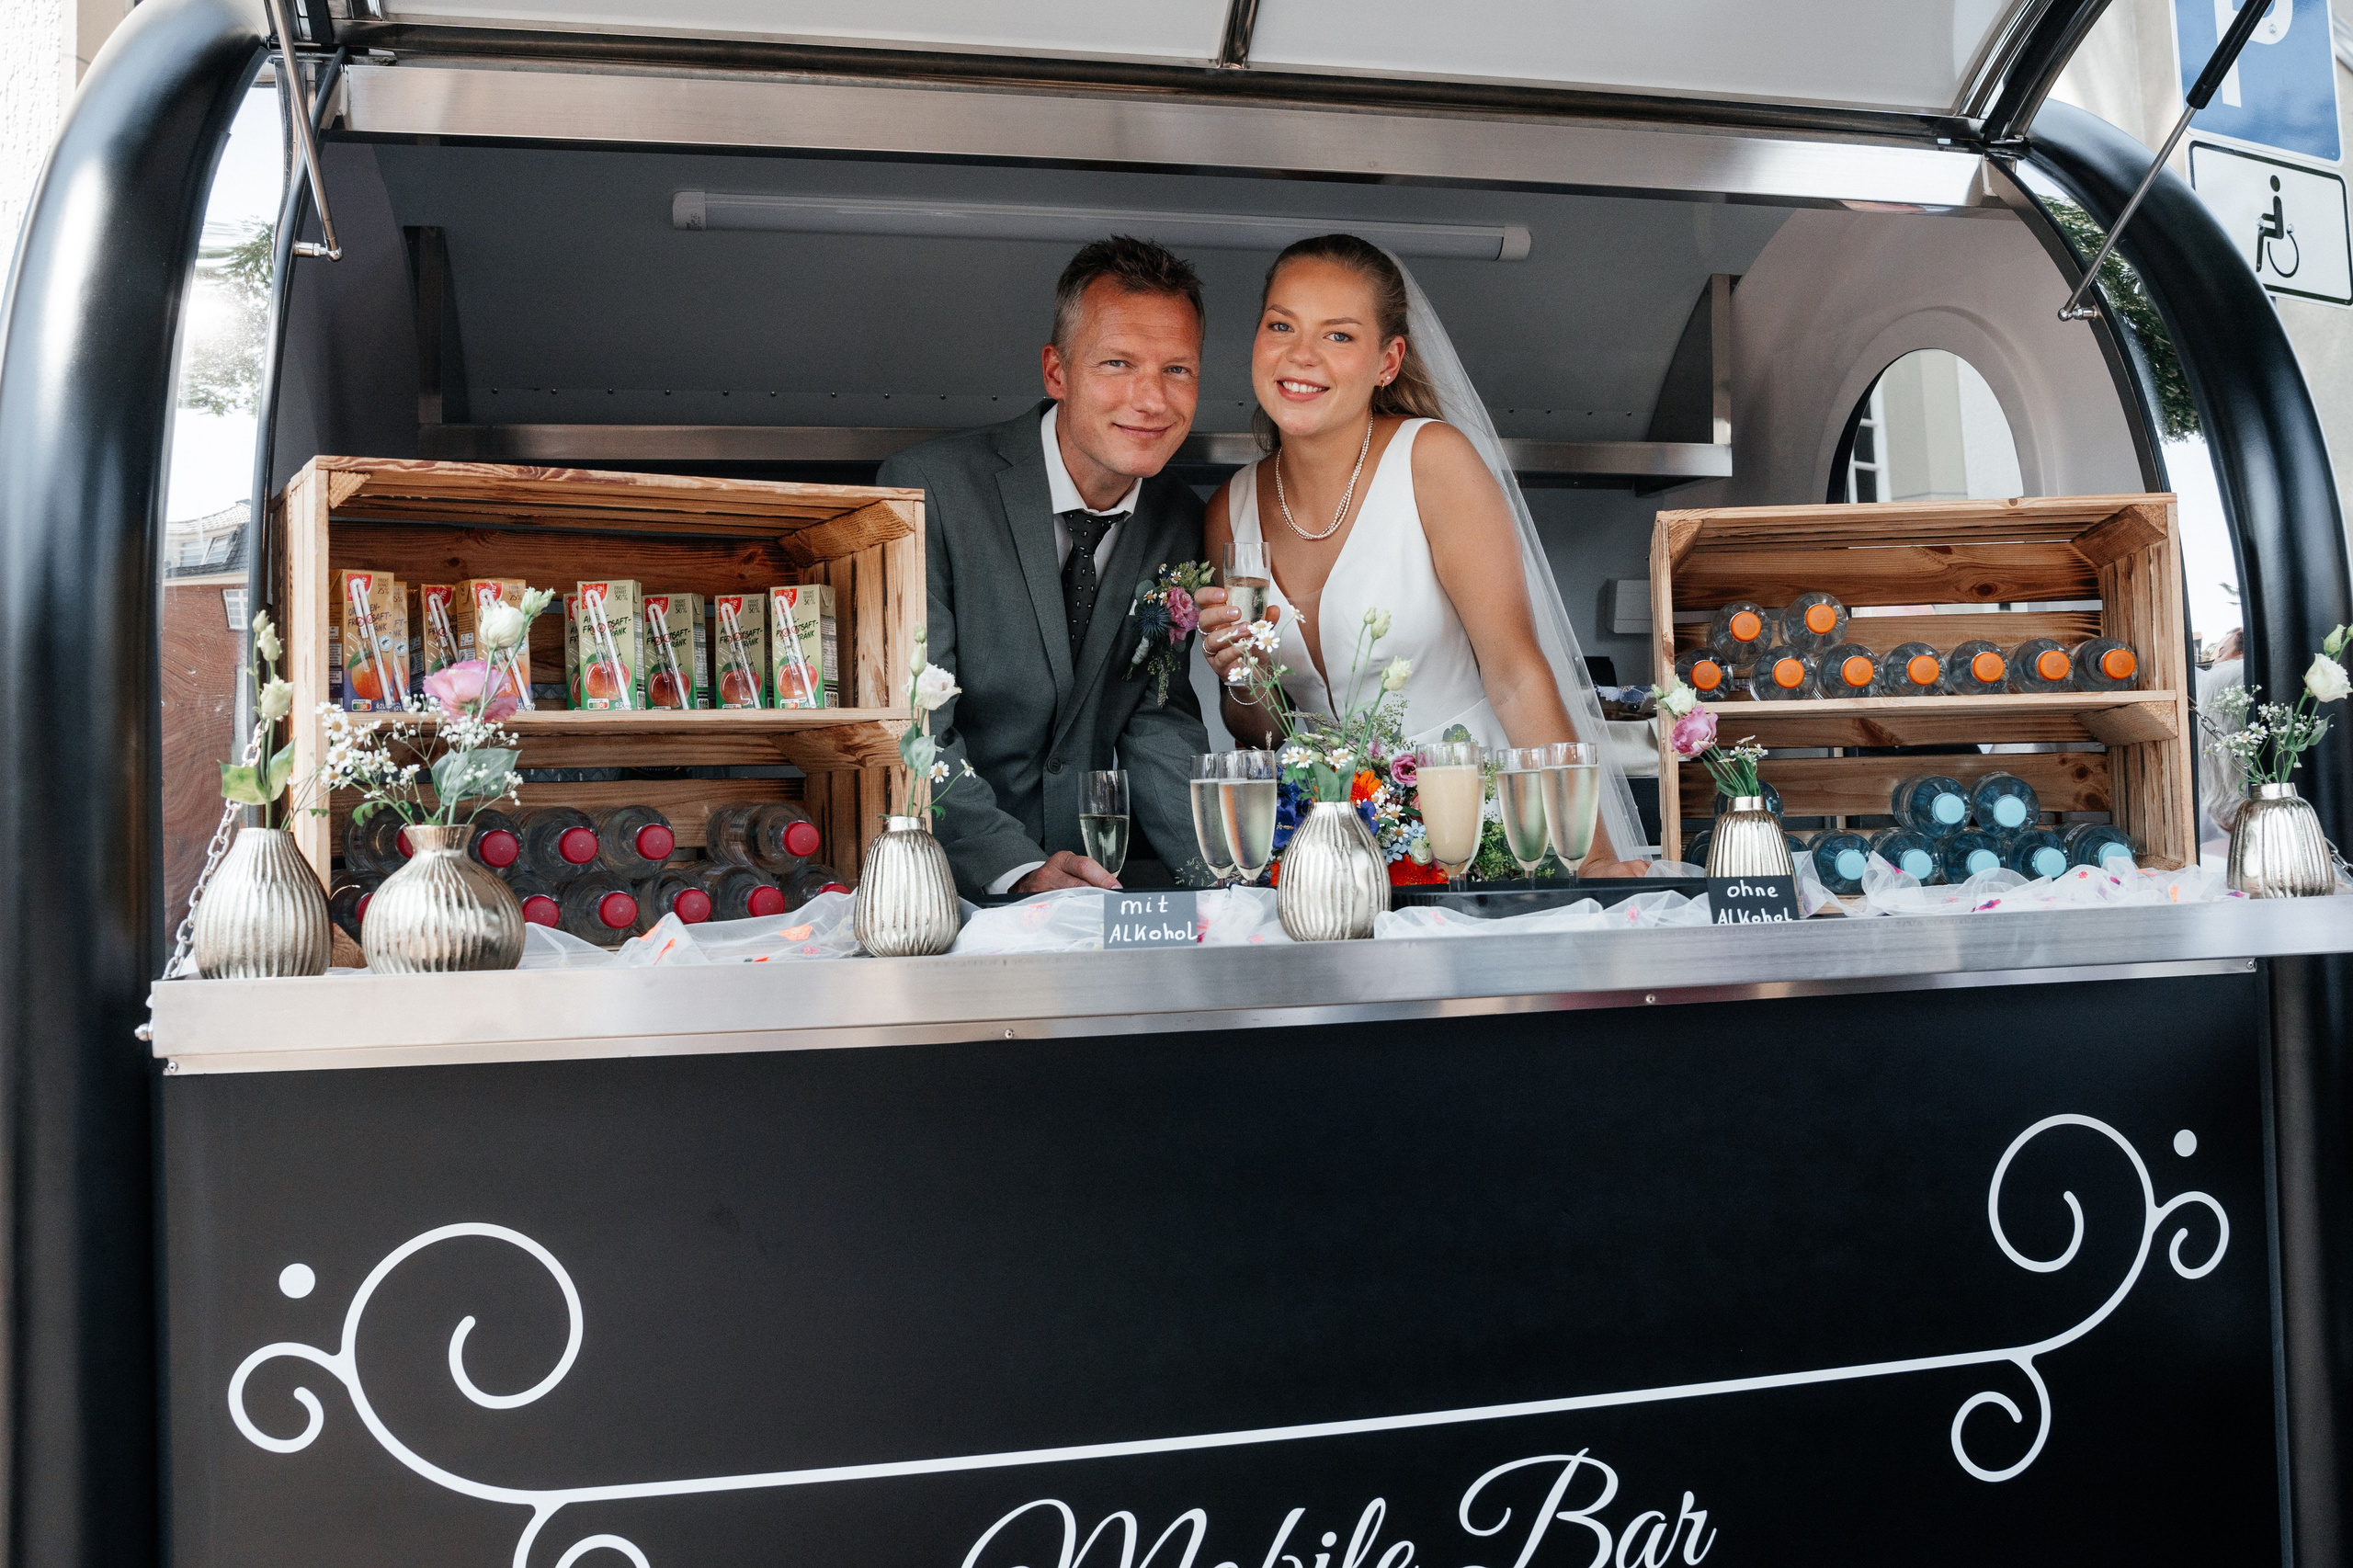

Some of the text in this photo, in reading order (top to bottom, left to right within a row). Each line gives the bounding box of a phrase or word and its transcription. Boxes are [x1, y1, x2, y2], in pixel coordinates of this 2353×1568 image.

[1726, 879, 1779, 898] ohne
[1120, 894, 1169, 915] mit
[1458, 1447, 1718, 1568] Bar
